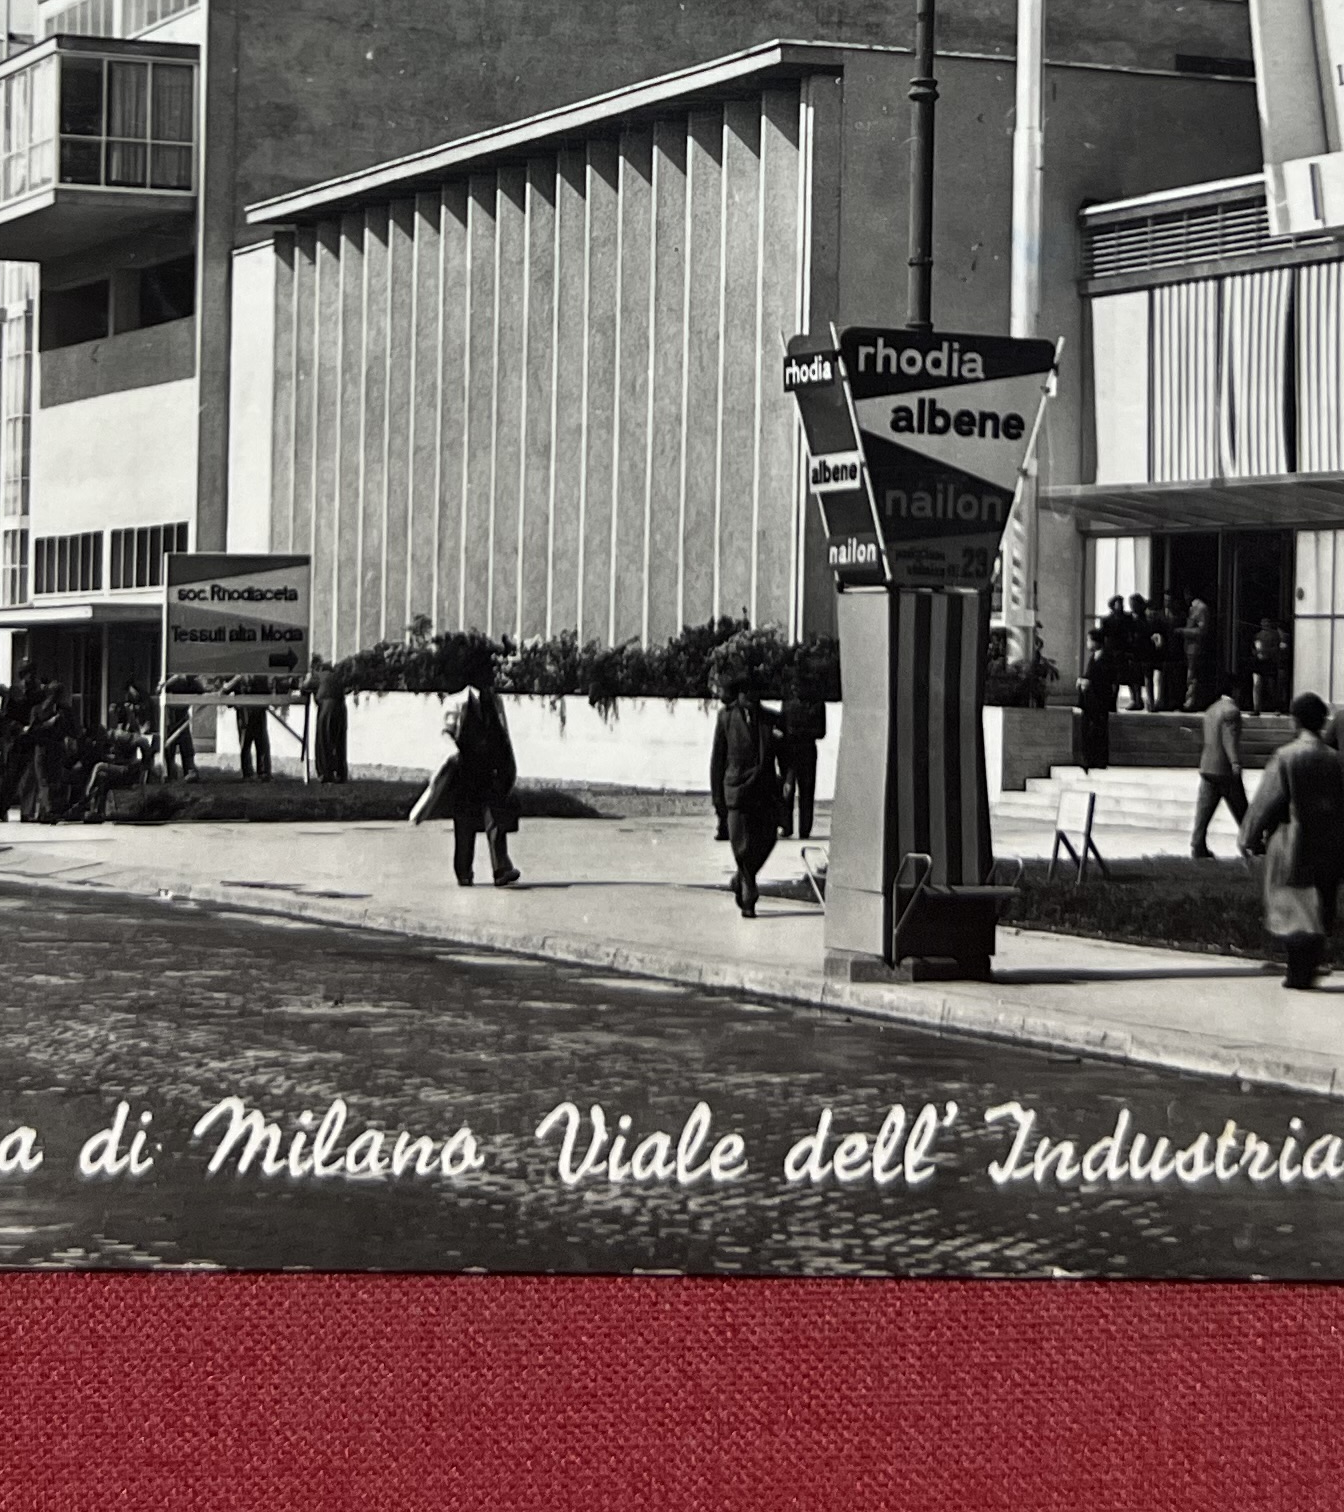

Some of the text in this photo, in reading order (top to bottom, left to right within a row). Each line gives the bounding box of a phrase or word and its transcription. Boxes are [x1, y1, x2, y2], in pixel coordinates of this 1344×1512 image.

[784, 355, 833, 385] rhodia
[858, 338, 985, 379] rhodia
[890, 398, 1025, 439] albene
[811, 460, 858, 484] albene
[884, 483, 1004, 522] nailon
[828, 538, 877, 565] nailon
